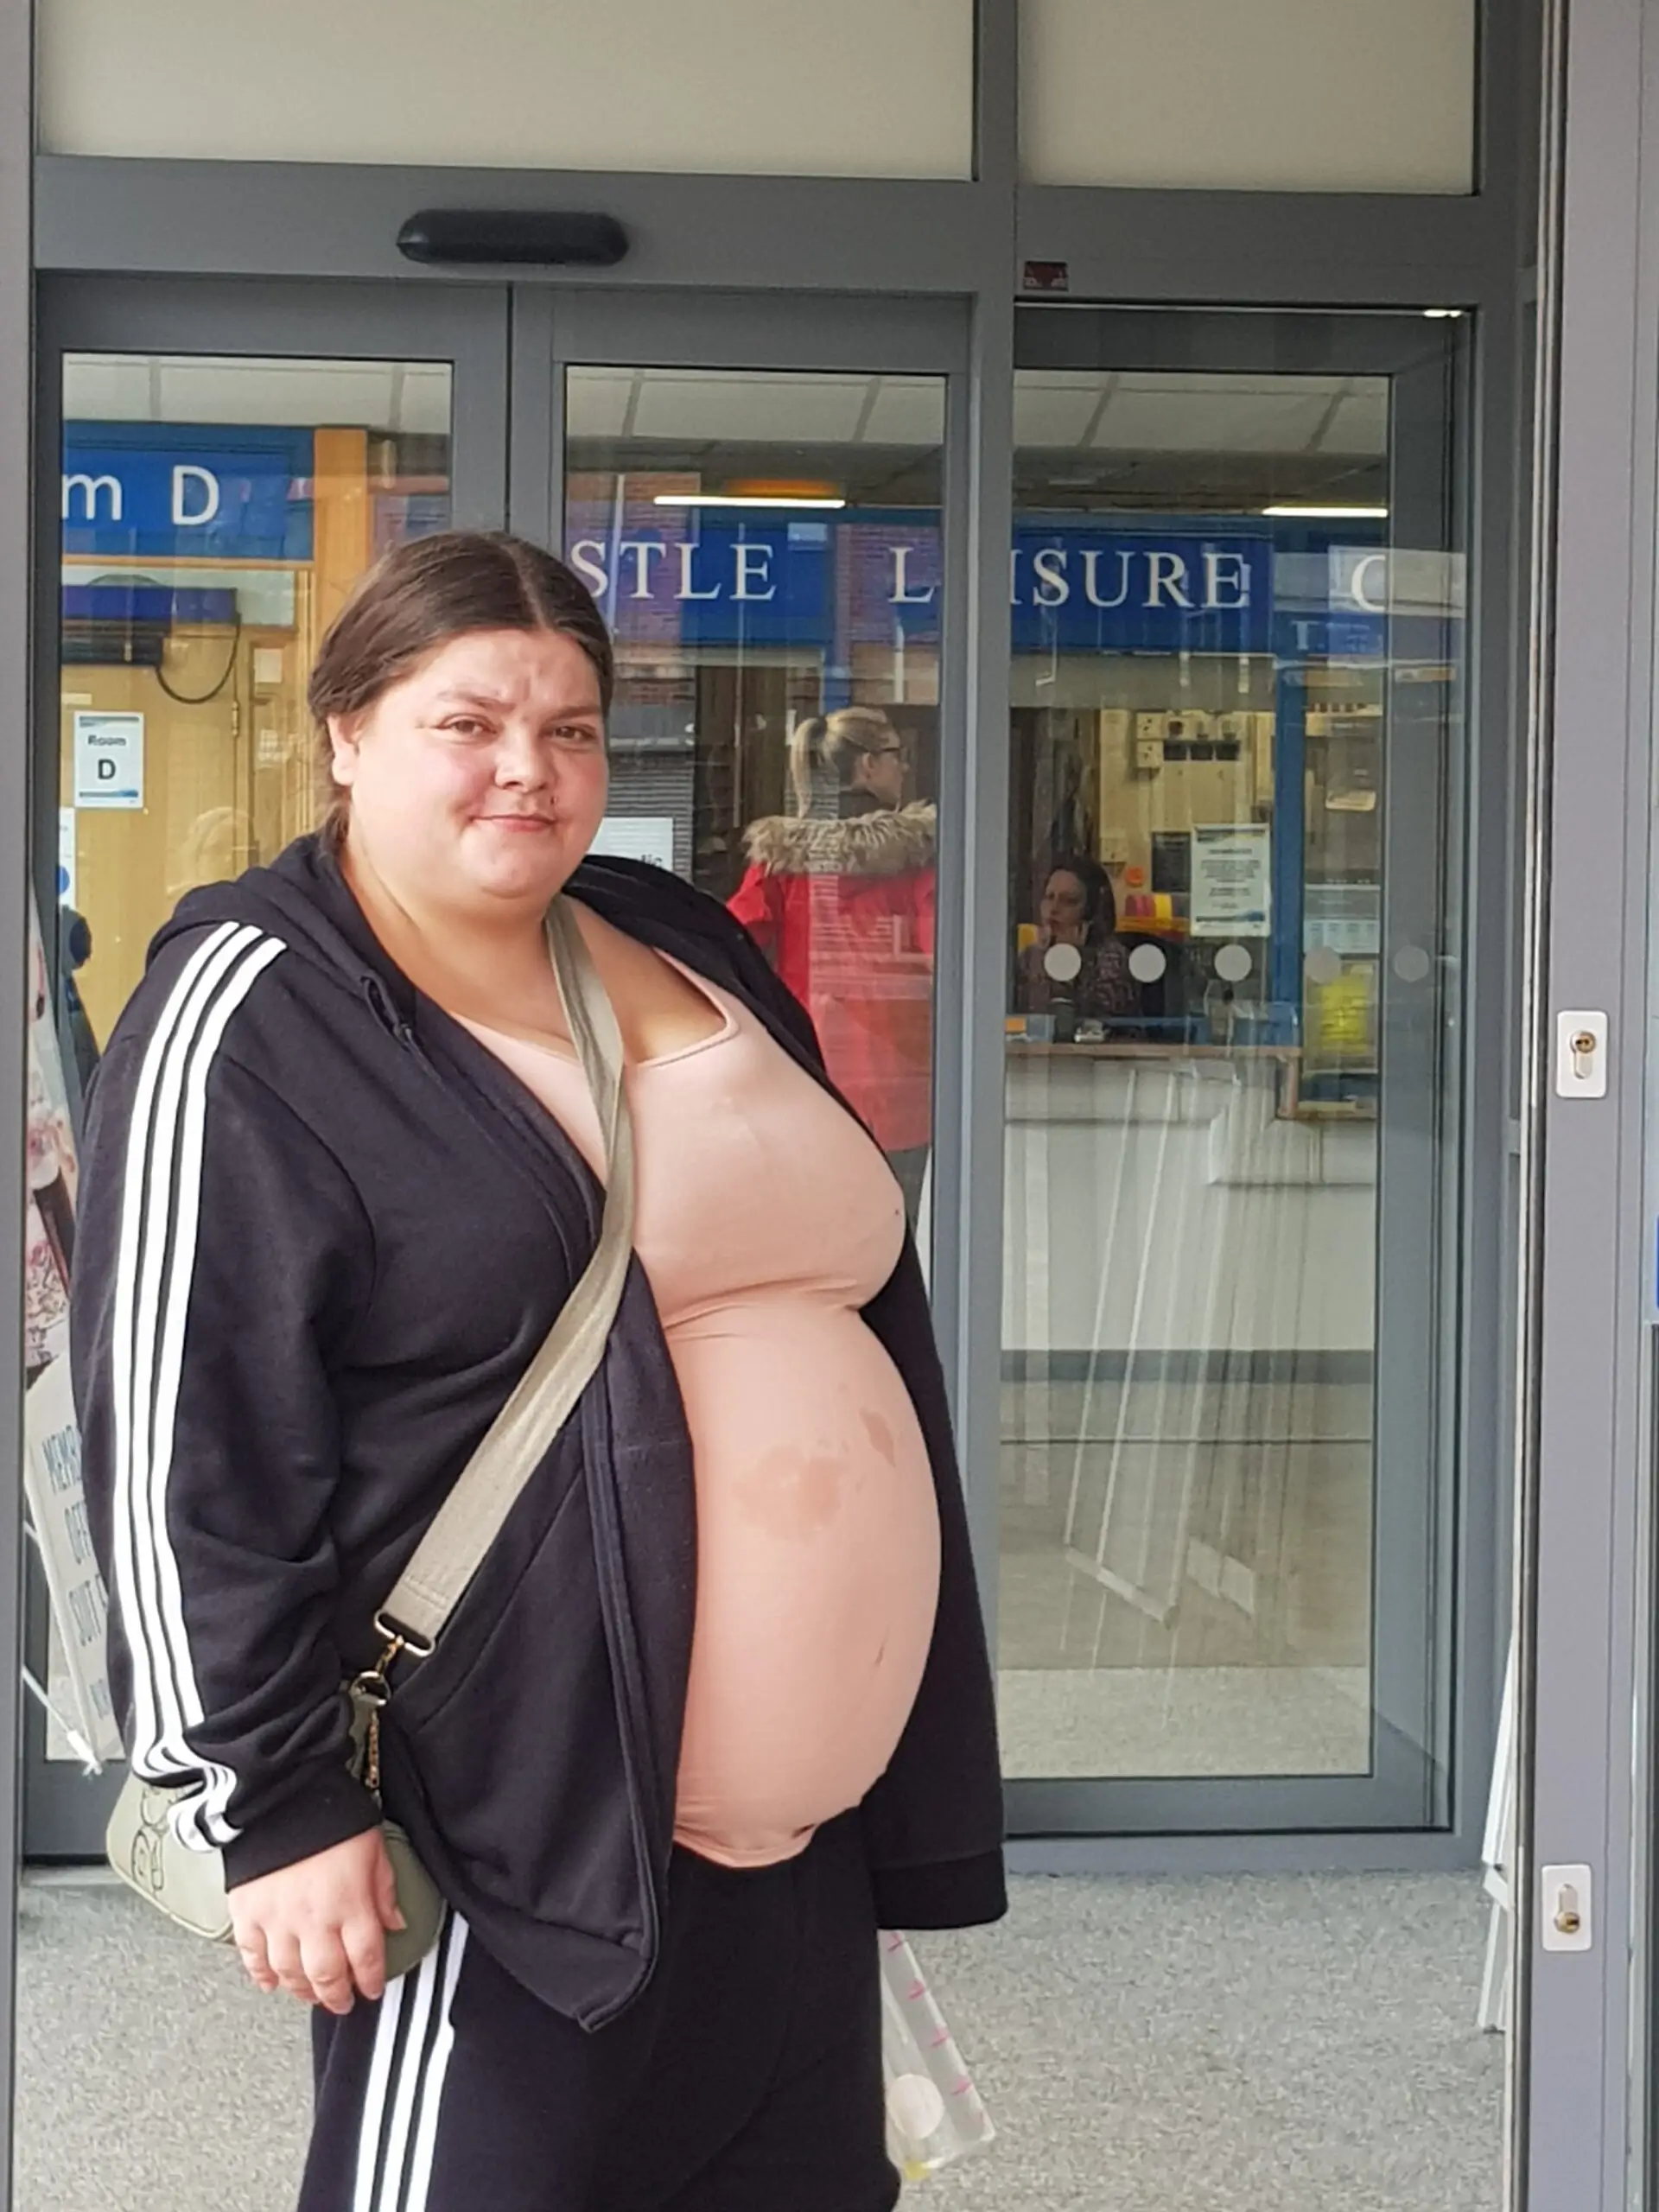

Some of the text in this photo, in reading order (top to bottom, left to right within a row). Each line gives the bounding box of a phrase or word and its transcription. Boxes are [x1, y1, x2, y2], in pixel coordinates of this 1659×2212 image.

[173, 465, 219, 525] D
[88, 735, 126, 747] Room
[98, 759, 116, 780] D
